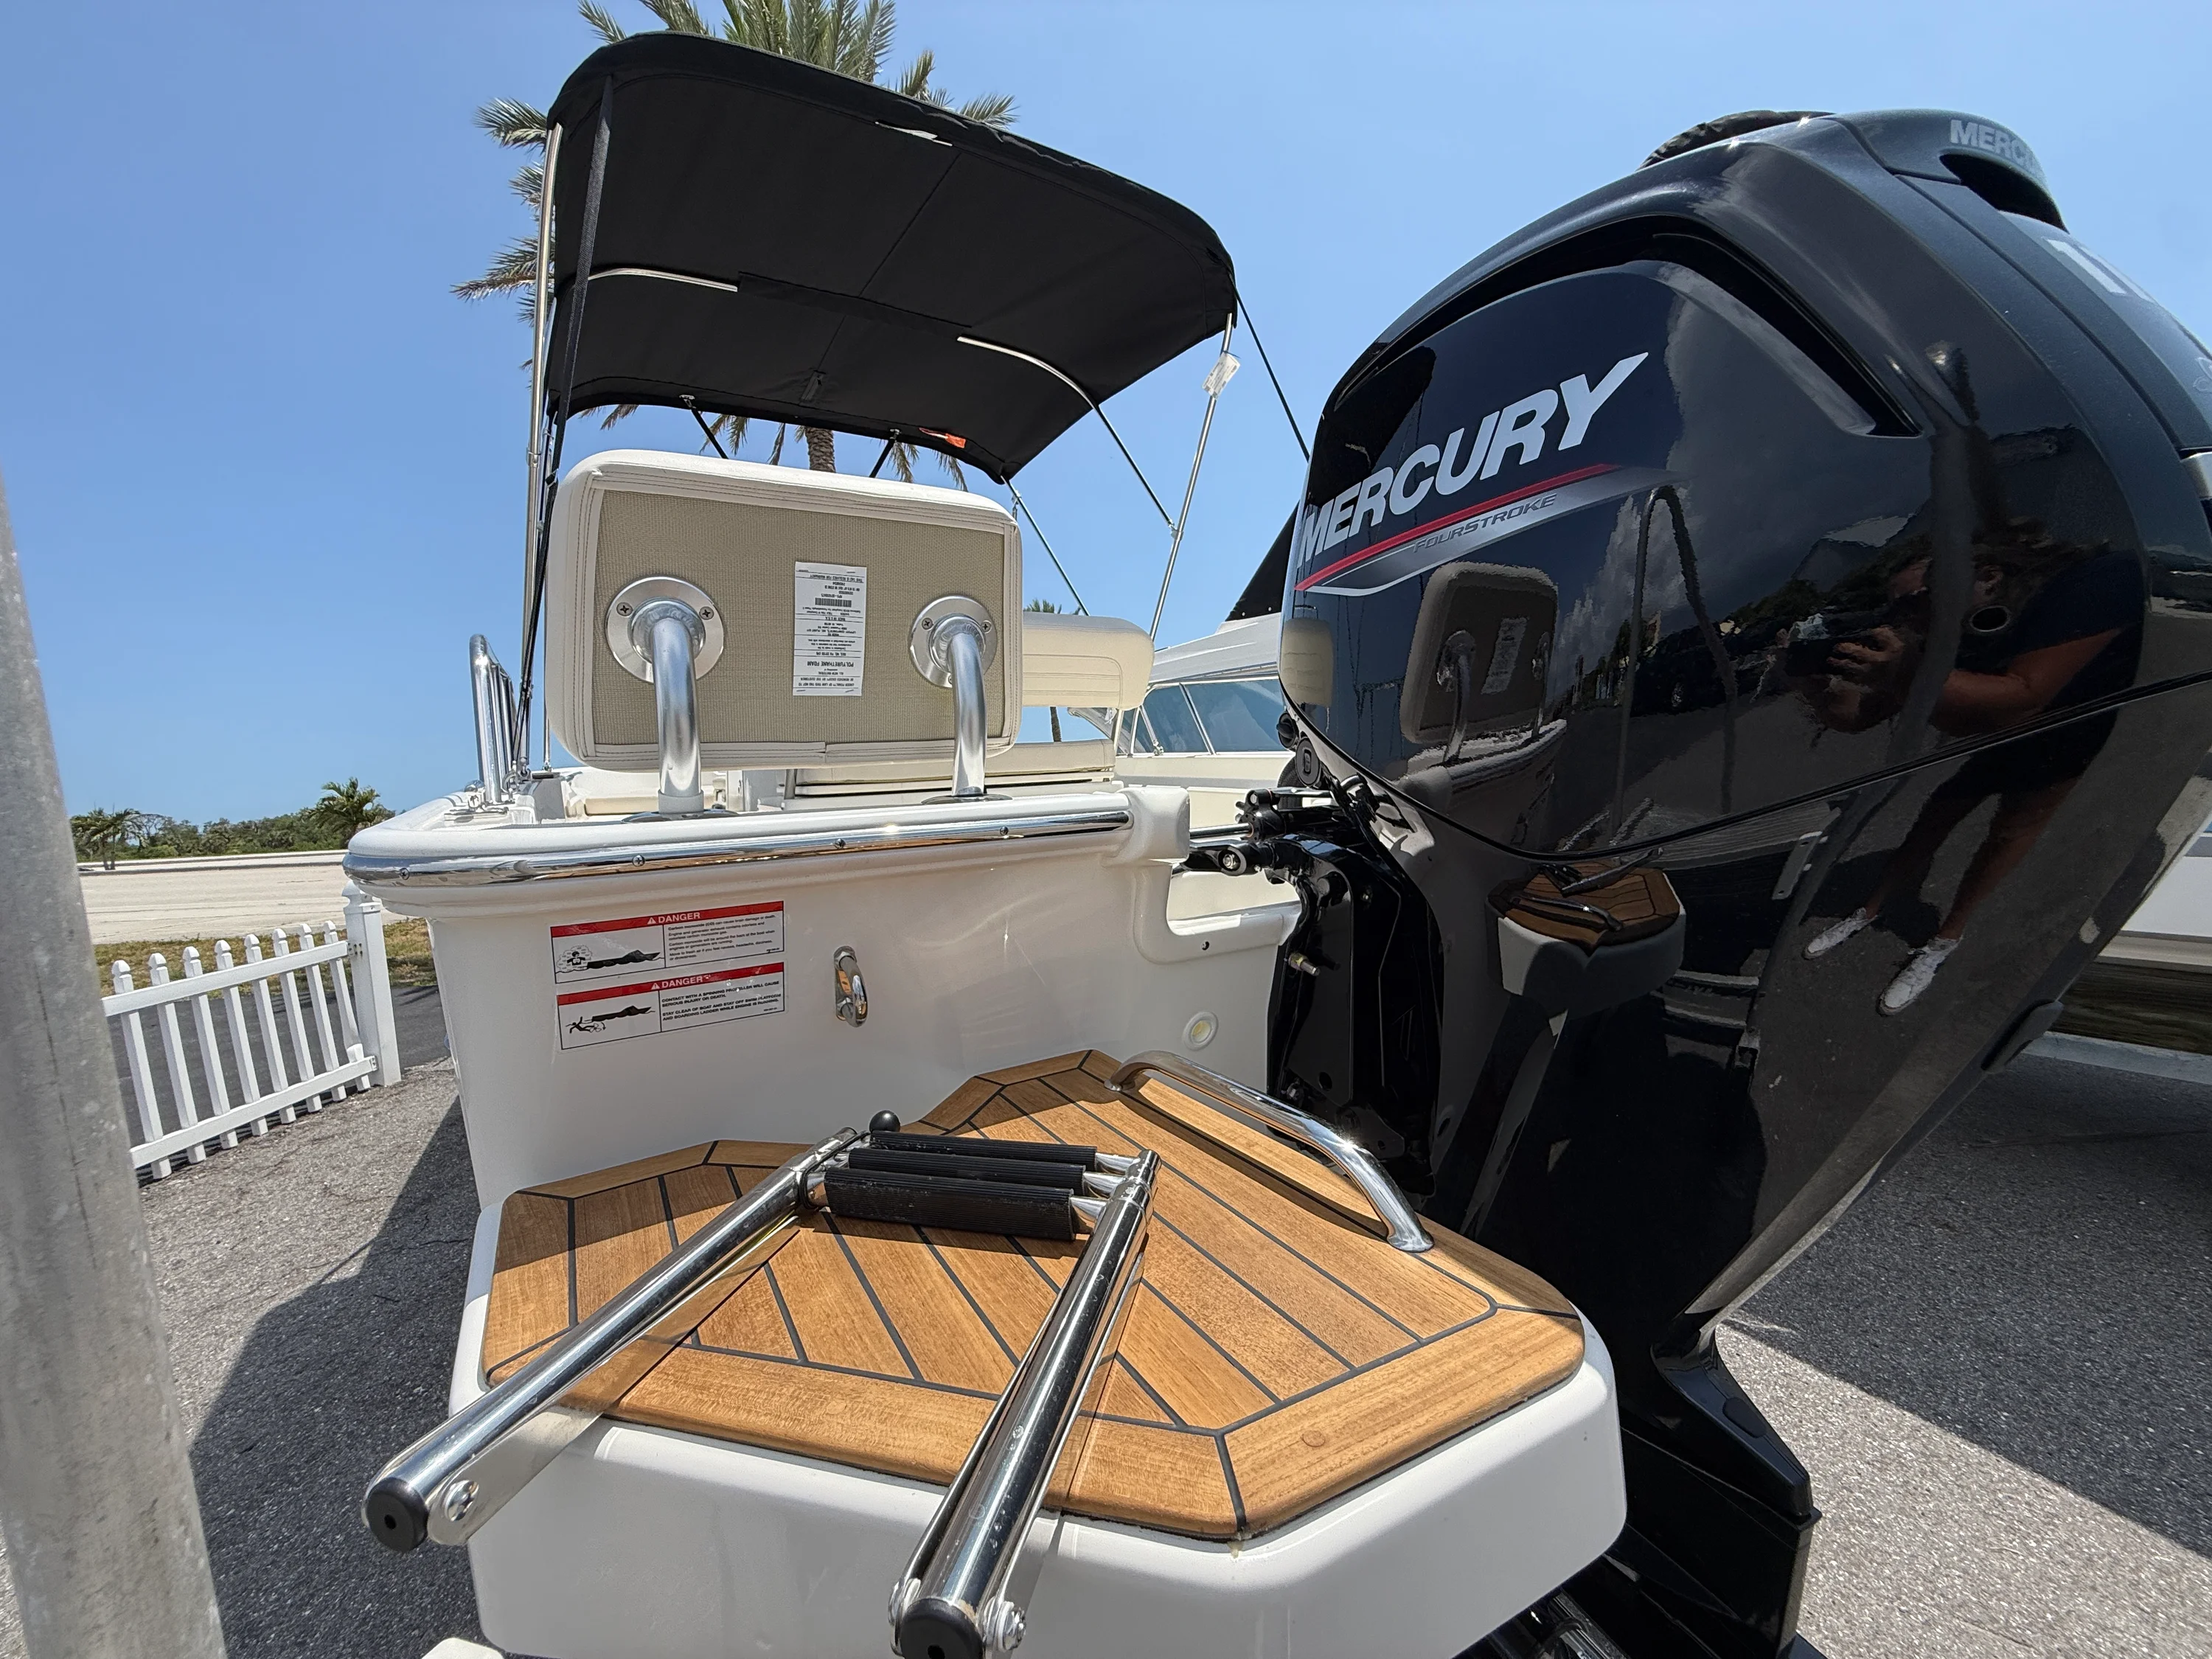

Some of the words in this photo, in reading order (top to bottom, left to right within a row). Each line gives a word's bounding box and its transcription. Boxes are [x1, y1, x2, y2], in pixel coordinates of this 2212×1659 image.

[1950, 119, 2037, 175] MERC
[1297, 352, 1649, 568] MERCURY
[1412, 493, 1557, 552] FOURSTROKE
[658, 912, 700, 923] DANGER
[661, 976, 703, 989] DANGER
